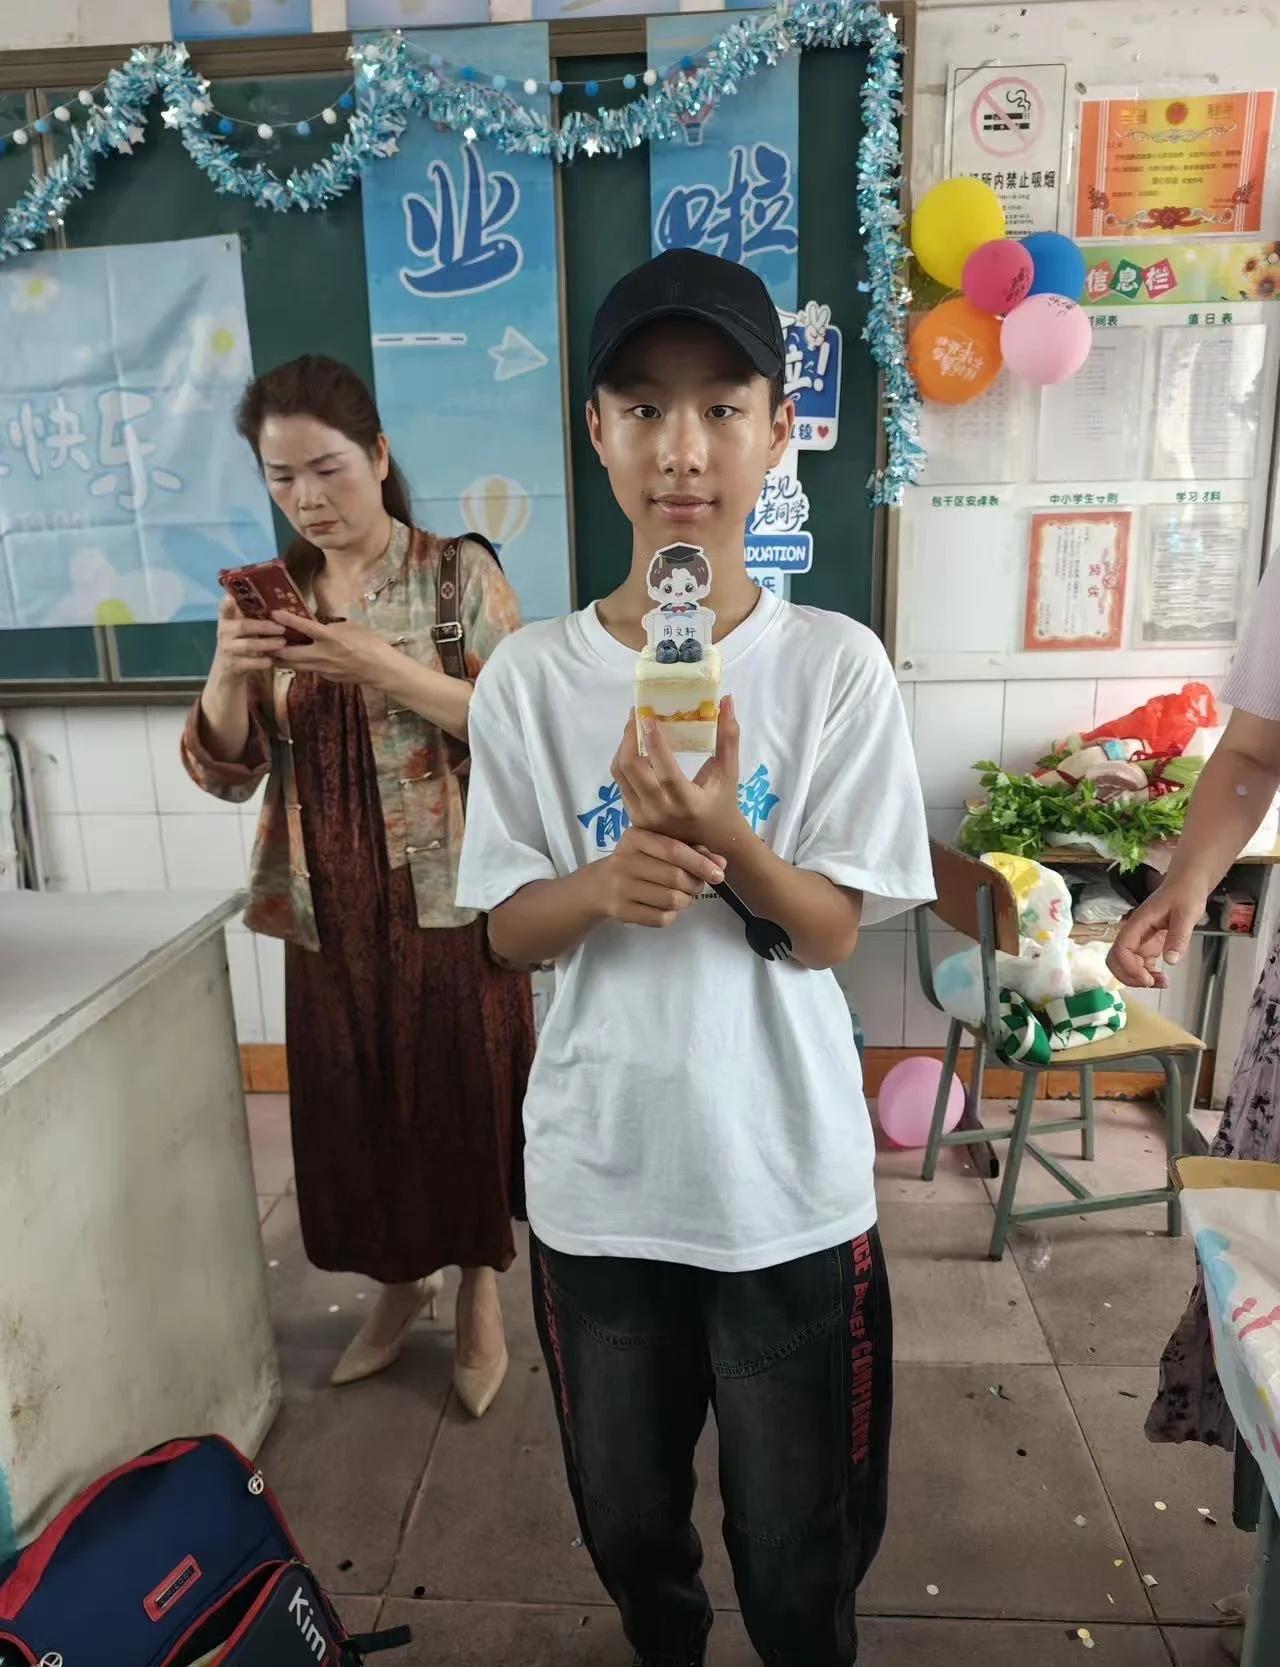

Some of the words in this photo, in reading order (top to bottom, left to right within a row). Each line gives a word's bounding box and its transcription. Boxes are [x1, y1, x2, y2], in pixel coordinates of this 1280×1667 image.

[655, 142, 798, 264] 啦
[400, 142, 523, 297] 业
[1086, 265, 1170, 293] 信息栏
[1187, 312, 1234, 326] 值日表
[0, 387, 184, 511] 快乐
[752, 499, 806, 531] 老同学
[744, 545, 806, 562] DUATION
[663, 624, 696, 638] 周文轩
[288, 1586, 327, 1662] Kim
